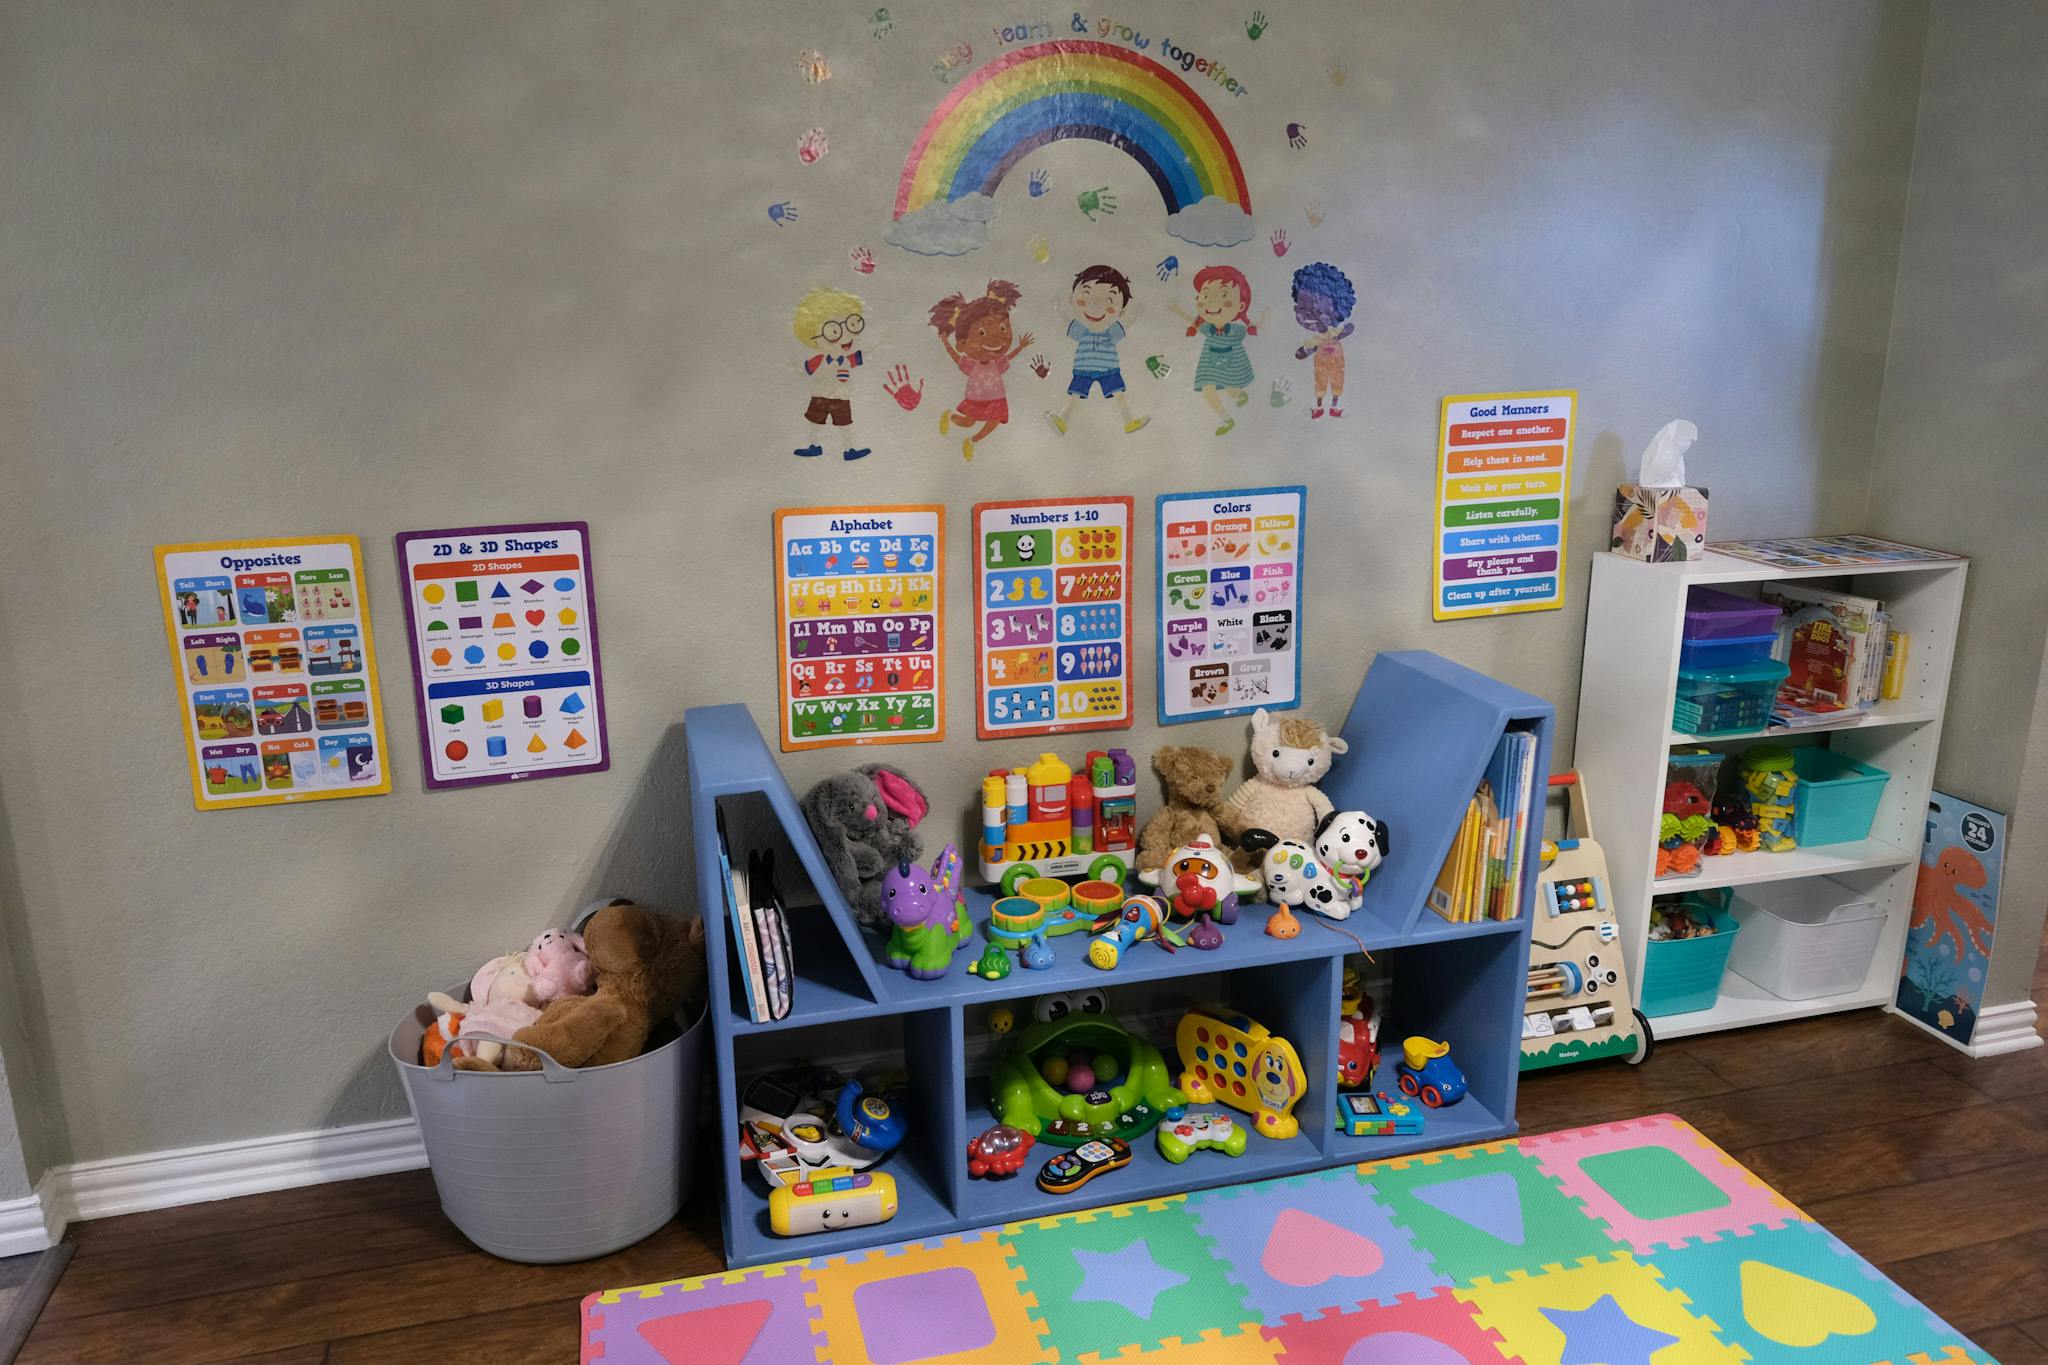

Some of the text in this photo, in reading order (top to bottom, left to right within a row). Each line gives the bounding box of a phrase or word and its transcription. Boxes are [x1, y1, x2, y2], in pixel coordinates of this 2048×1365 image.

[1071, 12, 1088, 33] &
[1097, 17, 1150, 49] grow
[1162, 36, 1248, 98] together
[1470, 404, 1549, 417] Good Manners
[1461, 429, 1494, 440] Respect
[1516, 425, 1553, 435] another.
[1463, 453, 1547, 467] Help those in need.
[1460, 480, 1547, 493] Wait for your turn.
[1214, 502, 1251, 514] Colors
[1466, 506, 1538, 520] Listen carefully.
[1010, 510, 1098, 525] Numbers 1-10
[1260, 519, 1290, 528] Yellow
[830, 519, 893, 533] Alphabet
[1179, 526, 1196, 534] Red
[1214, 523, 1248, 532] Orange
[1460, 533, 1542, 547] Share with others.
[433, 539, 558, 556] 2D & 3D Shapes
[790, 538, 929, 556] Aa Bb Cc Dd Ee
[990, 539, 1003, 562] 1
[1060, 536, 1075, 558] 6
[220, 554, 302, 571] Opposites
[472, 561, 522, 571] 2D Shapes
[1468, 554, 1534, 569] Say please and
[1221, 571, 1240, 579] Blue
[1263, 567, 1283, 575] Pink
[1477, 566, 1524, 576] thank you.
[205, 579, 225, 587] Short
[243, 575, 288, 586] Big Small
[1174, 575, 1201, 584] Green
[792, 578, 930, 598] Ff Gg Hh Ii Jj Kk
[990, 580, 1004, 602] 2
[1060, 576, 1076, 597] 7
[1448, 583, 1551, 600] Clean up after yourself.
[1218, 618, 1243, 627] White
[1260, 613, 1285, 623] Black
[334, 627, 354, 635] Under
[794, 618, 931, 637] Ll Mm Nn Oo Pp
[991, 618, 1005, 640] 3
[1061, 614, 1075, 636] 8
[1173, 622, 1202, 633] Purple
[1814, 622, 1833, 631] FIRE
[216, 635, 236, 644] Right
[792, 657, 931, 680] Qq Rr Ss Tt Uu
[992, 658, 1006, 678] 4
[1061, 652, 1075, 674] 9
[1240, 664, 1262, 673] Gray
[1195, 668, 1224, 677] Brown
[316, 685, 333, 694] Open
[486, 679, 535, 690] 3D Shapes
[794, 696, 931, 716] Vv Ww Xx Yy Zz
[994, 696, 1008, 718] 5
[1060, 691, 1088, 713] 10
[294, 741, 309, 749] Cold
[324, 735, 368, 747] Day Night
[236, 746, 250, 755] Dry
[1104, 771, 1109, 785] 1
[1968, 822, 1987, 842] 24
[1136, 1105, 1148, 1114] 5
[1055, 1120, 1063, 1129] 1
[1121, 1115, 1133, 1123] 4
[1078, 1122, 1088, 1131] 2
[1101, 1122, 1113, 1130] 3
